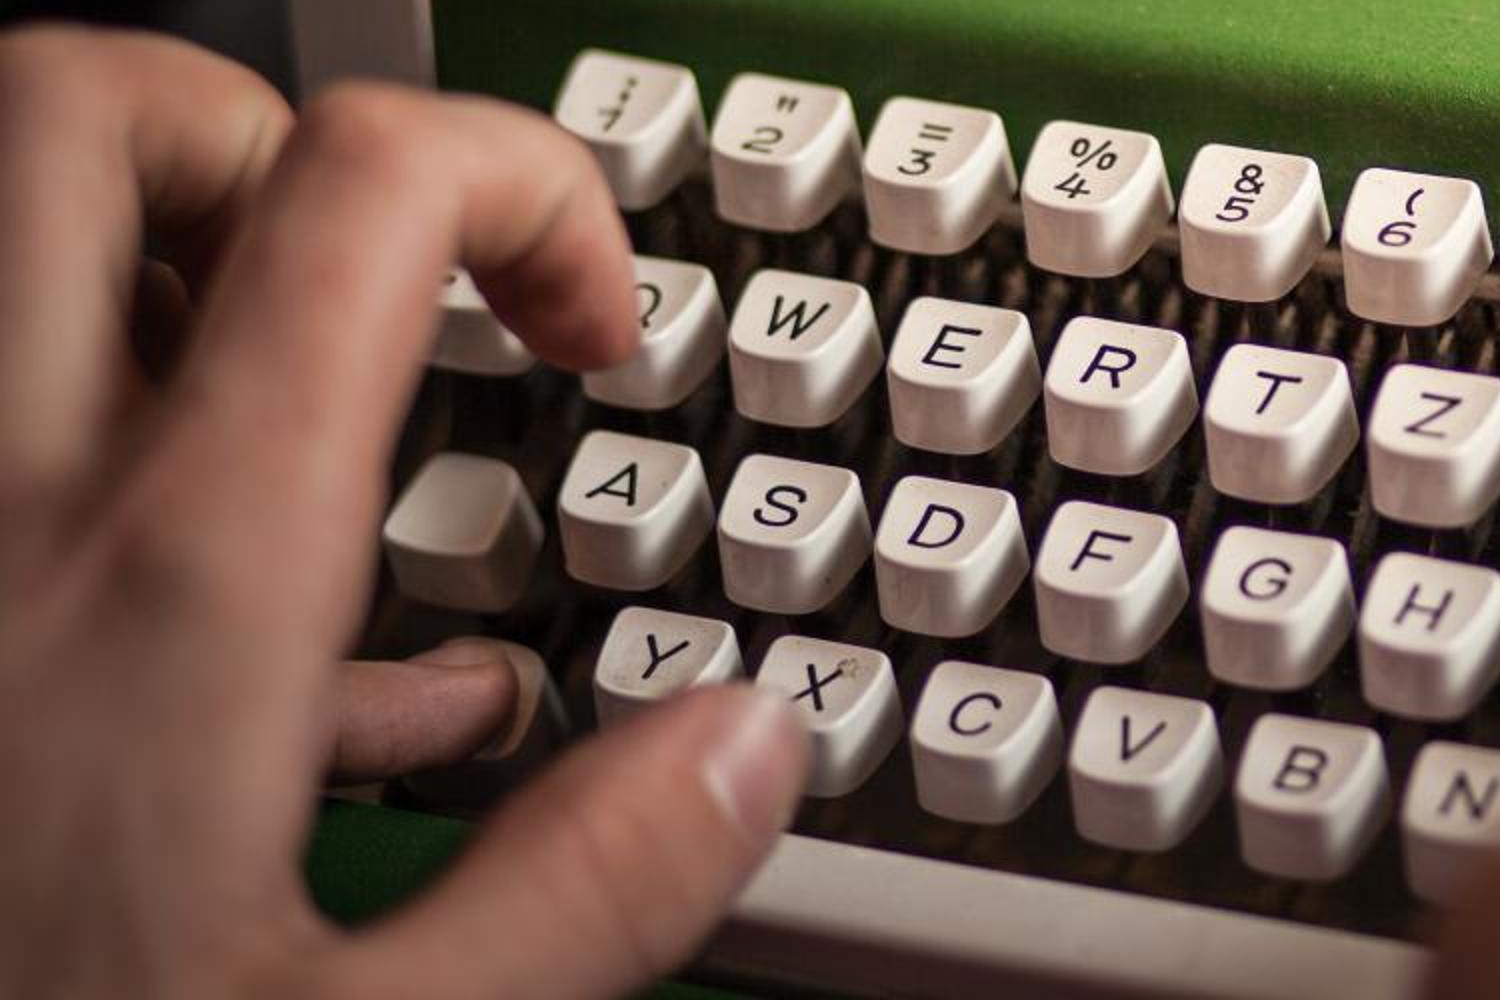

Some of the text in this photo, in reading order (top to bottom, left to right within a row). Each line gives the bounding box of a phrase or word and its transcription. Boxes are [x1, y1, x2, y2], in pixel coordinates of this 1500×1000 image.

[740, 126, 785, 154] 2
[897, 149, 937, 176] 3
[1069, 136, 1118, 172] %
[1054, 172, 1091, 199] 4
[1234, 163, 1265, 195] &
[1215, 196, 1256, 222] 5
[1404, 188, 1424, 216] (
[1377, 221, 1418, 247] 6
[766, 294, 832, 341] W
[921, 323, 983, 370] E
[1079, 344, 1138, 389] R
[1255, 370, 1304, 415] T
[1403, 391, 1463, 438] Z
[584, 461, 638, 507] A
[752, 484, 808, 528] S
[906, 503, 966, 549] D
[1070, 529, 1133, 572] F
[1239, 557, 1293, 601] G
[1393, 581, 1455, 631] H
[642, 633, 690, 680] Y
[791, 662, 843, 712] X
[949, 691, 1003, 736] C
[1119, 714, 1168, 763] V
[1272, 743, 1330, 794] B
